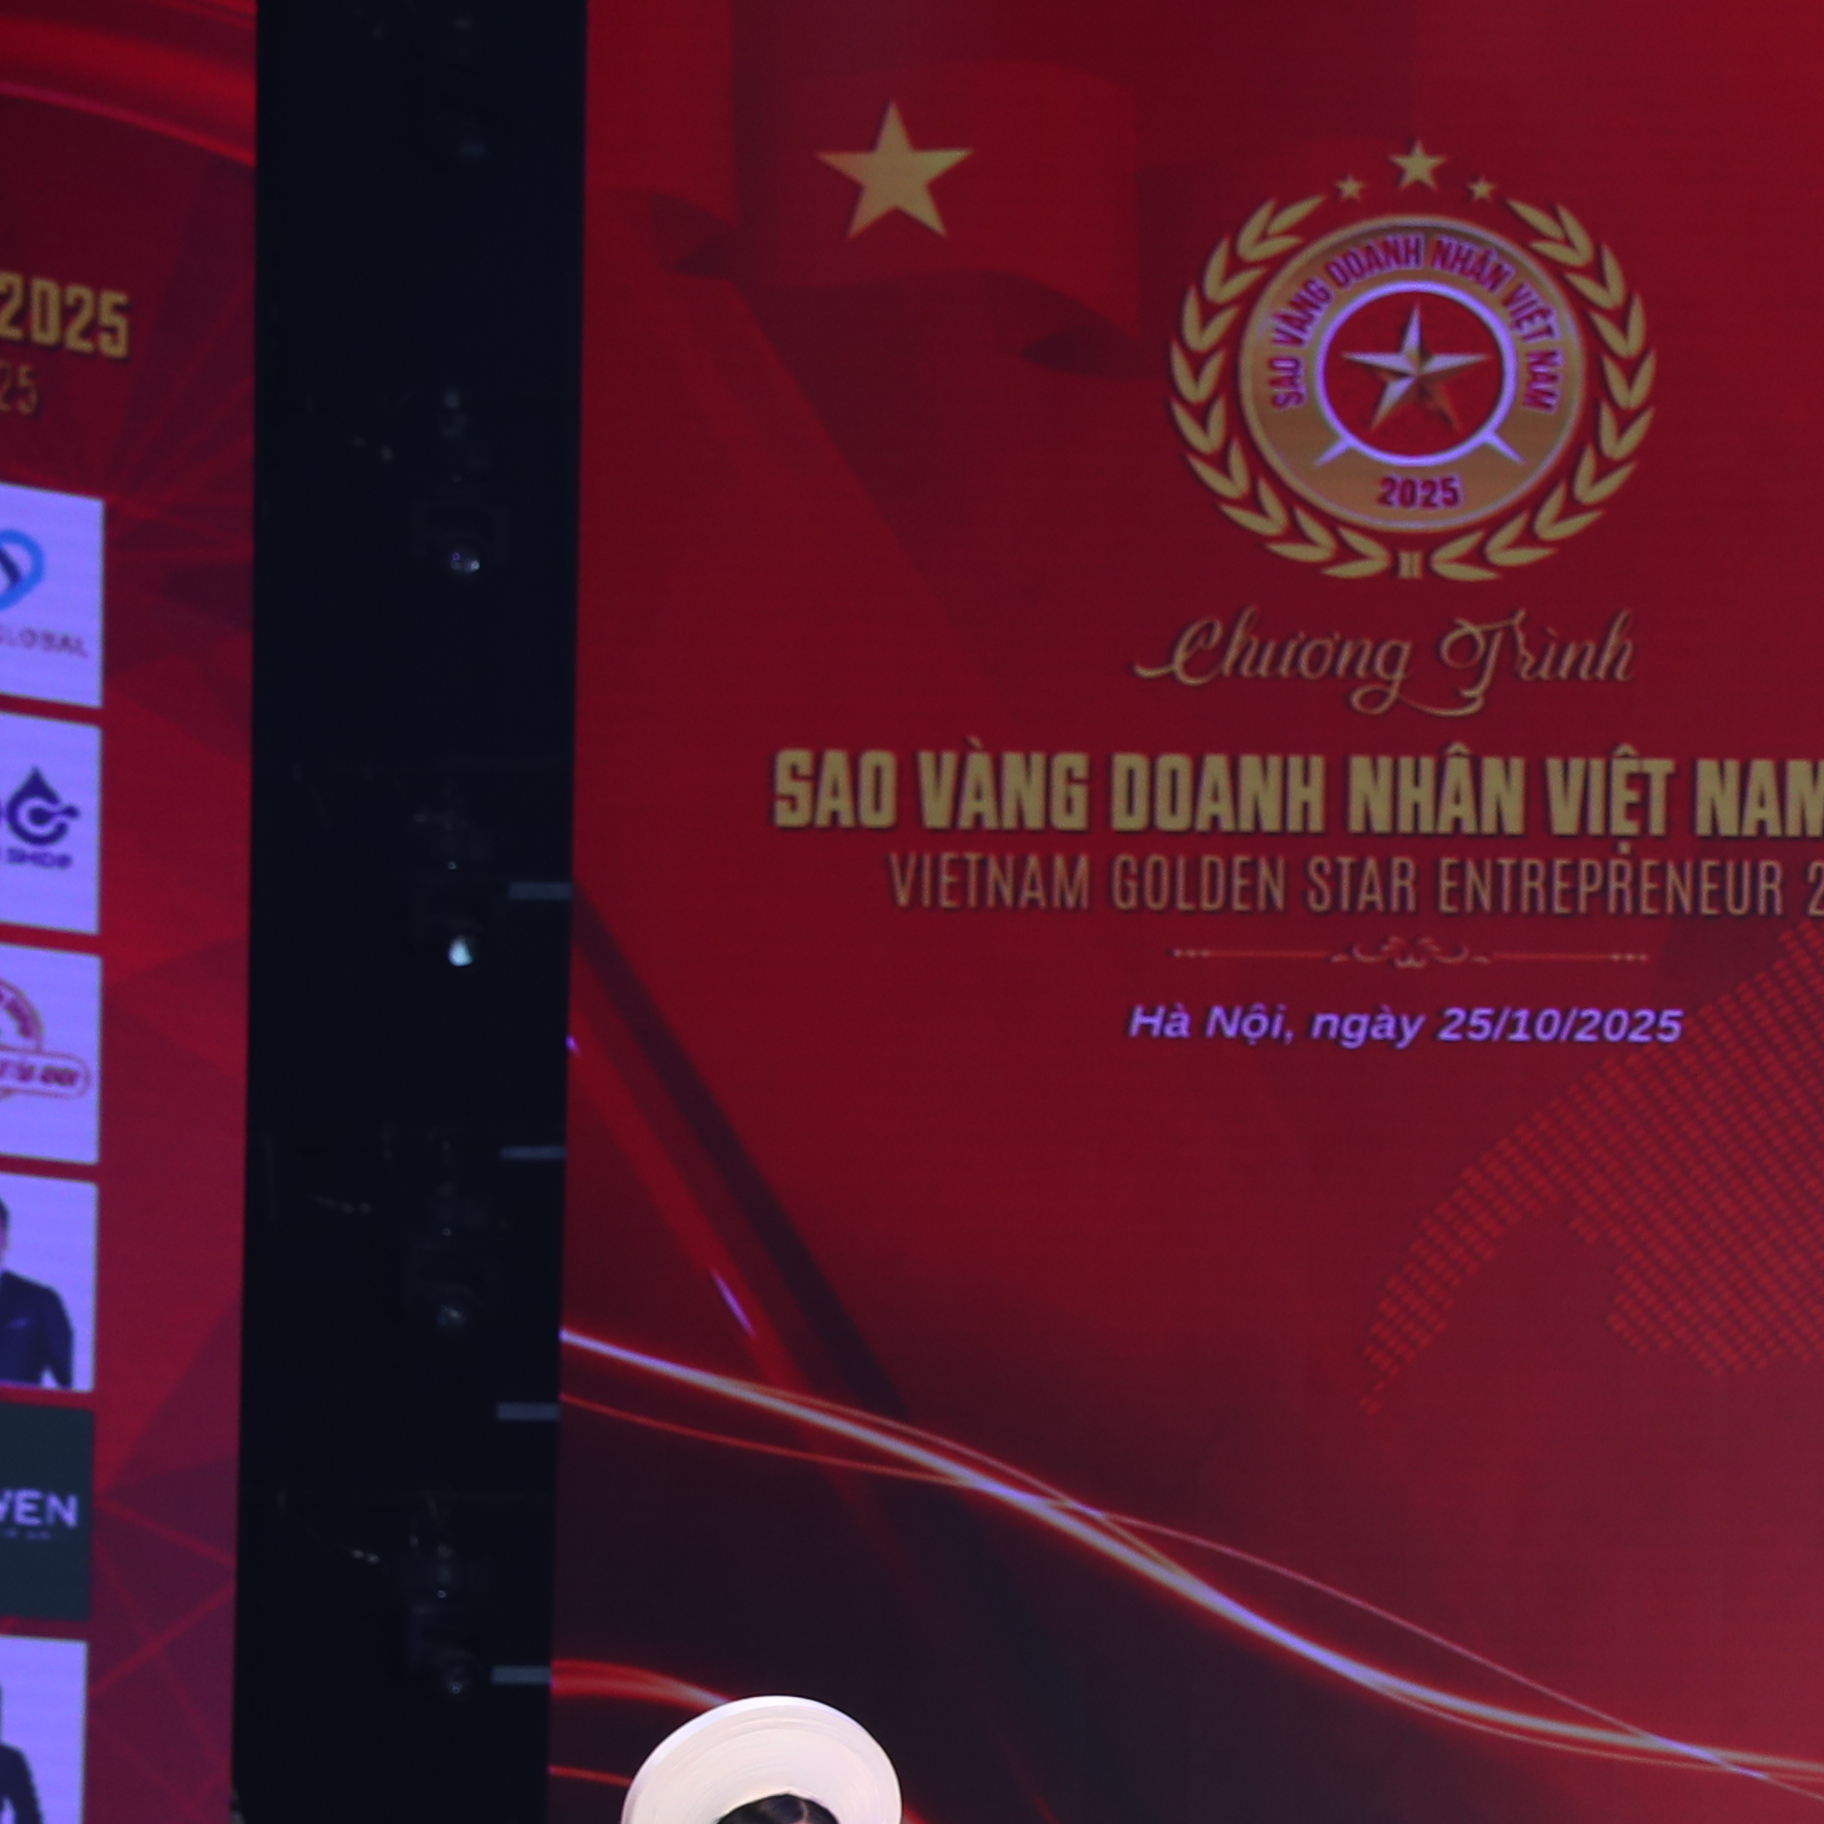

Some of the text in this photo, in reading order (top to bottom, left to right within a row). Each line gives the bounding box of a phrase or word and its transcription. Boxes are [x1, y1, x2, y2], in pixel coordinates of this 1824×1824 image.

[0, 270, 129, 359] 2025
[1378, 475, 1462, 508] 2025
[1135, 605, 1634, 716] Chương Trình
[773, 748, 897, 828] SAO
[917, 735, 1089, 831] VÀNG
[1112, 753, 1325, 833] DOANH
[1348, 742, 1523, 836] NHÂN
[1546, 744, 1675, 855] VIỆT
[890, 851, 1089, 910] VIETNAM
[1112, 854, 1286, 912] GOLDEN
[1307, 856, 1417, 912] STAR
[1438, 857, 1784, 916] ENTREPRENEUR
[1129, 1004, 1683, 1049] Hà Nội, ngày 25/10/2025
